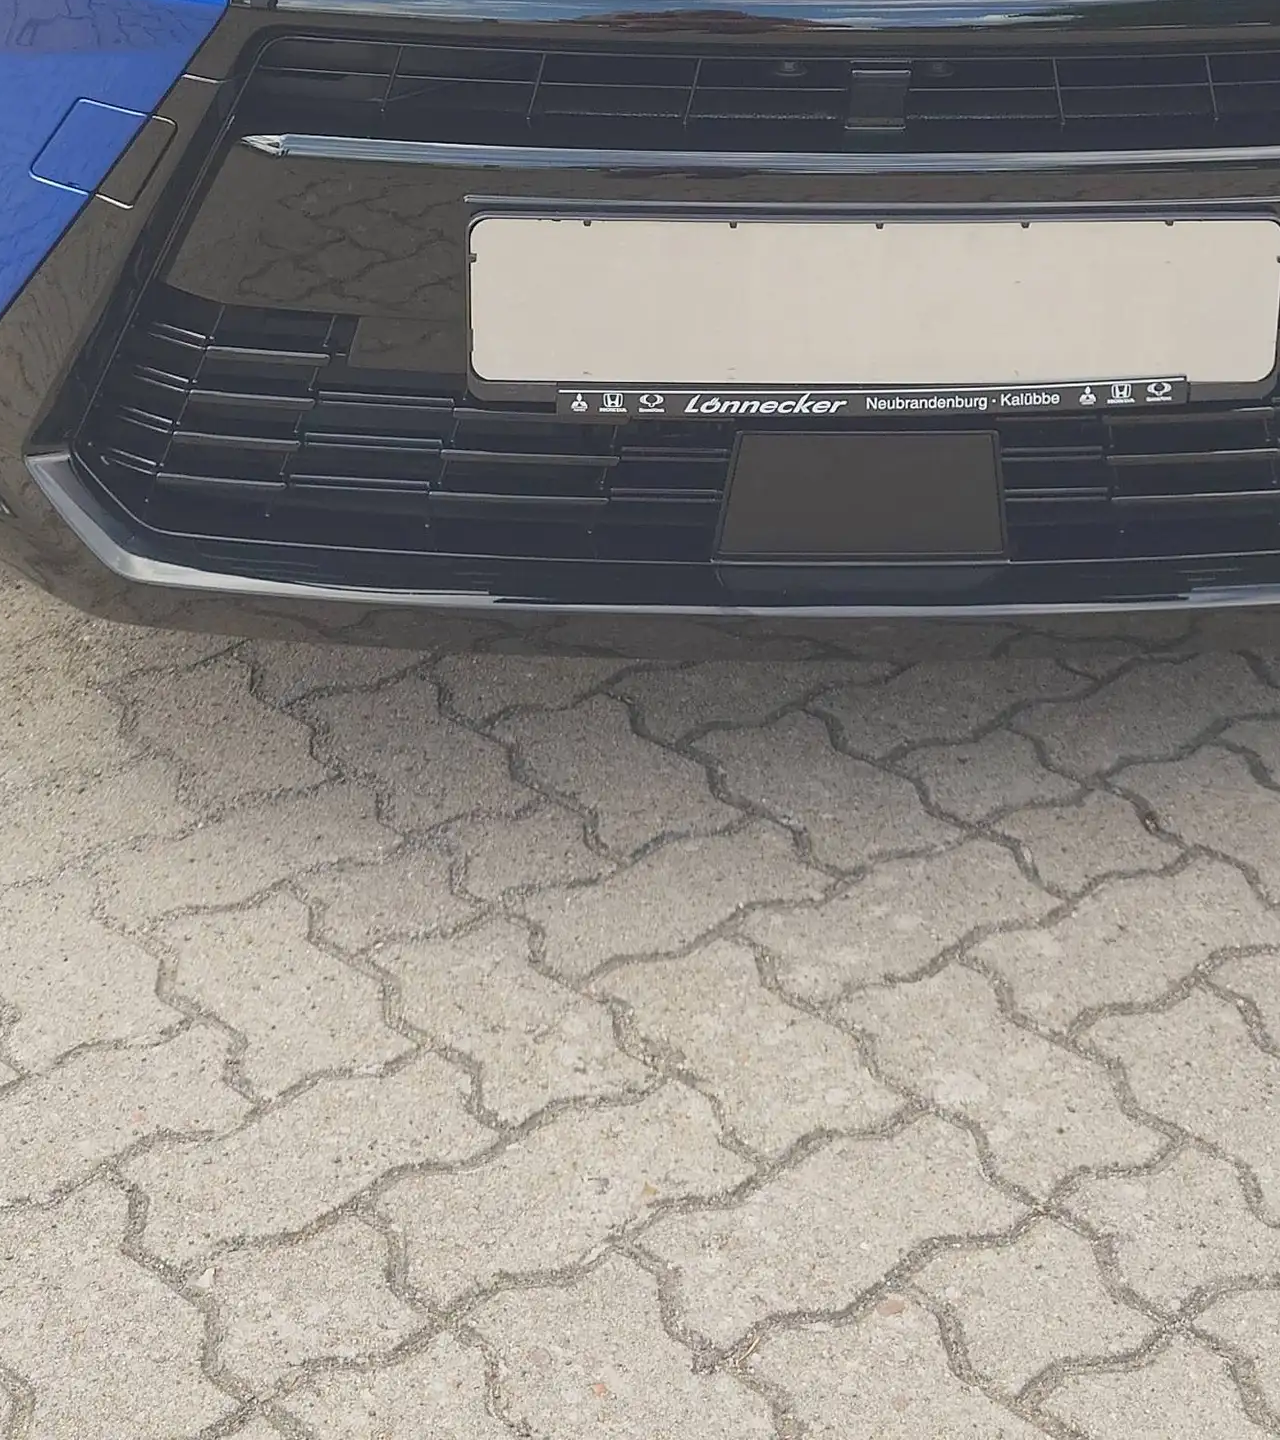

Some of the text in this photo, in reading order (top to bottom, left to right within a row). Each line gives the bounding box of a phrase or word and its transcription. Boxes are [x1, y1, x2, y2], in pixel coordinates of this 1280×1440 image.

[684, 392, 1061, 415] Lönnecker Neubrandenburg Kalübbe
